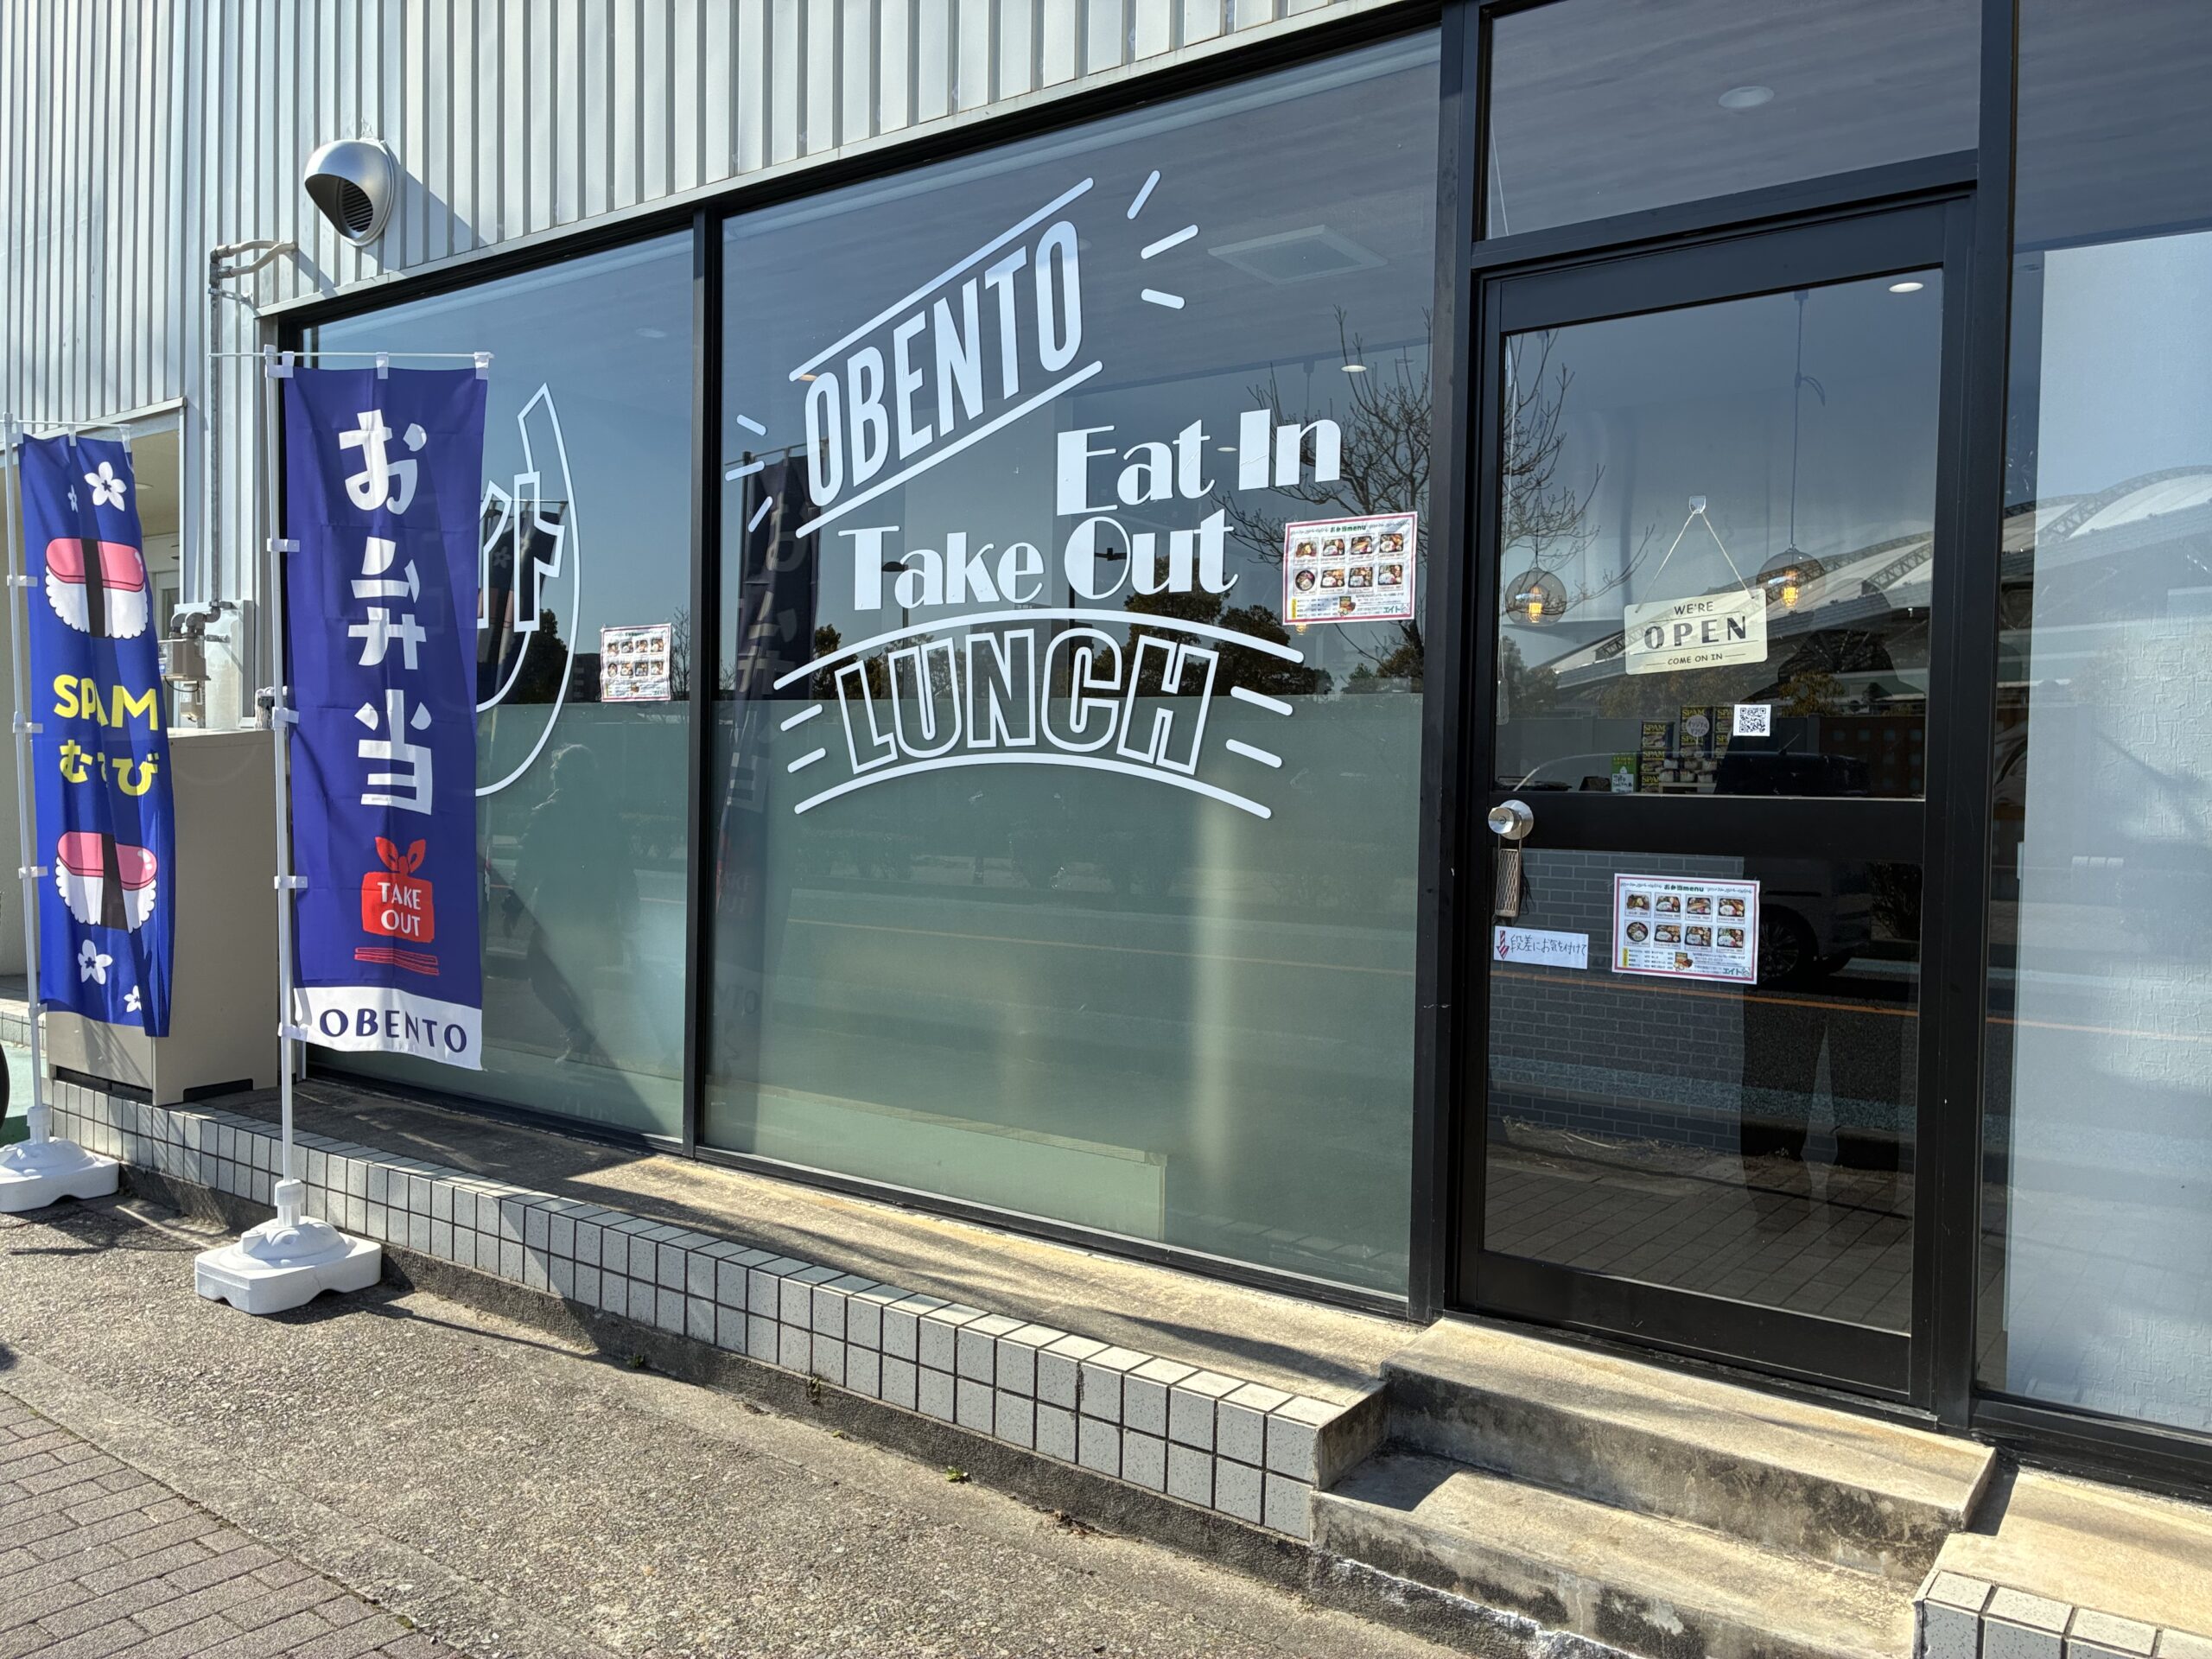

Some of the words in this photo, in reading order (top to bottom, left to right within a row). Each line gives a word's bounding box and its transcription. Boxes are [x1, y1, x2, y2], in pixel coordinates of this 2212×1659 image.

[804, 220, 1084, 507] OBENTO
[1057, 419, 1215, 517] Eat
[1238, 409, 1342, 491] In
[837, 525, 1045, 611] Take
[1064, 508, 1240, 601] Out
[339, 409, 433, 816] お弁当
[1674, 601, 1713, 615] WE'RE
[1644, 616, 1746, 650] OPEN
[1668, 655, 1692, 665] COME
[1694, 654, 1708, 663] ON
[54, 674, 159, 731] SPAM
[834, 628, 1220, 775] LUNCH
[1643, 750, 1666, 759] SPAM
[378, 882, 423, 910] TAKE
[381, 909, 421, 937] OUT
[1510, 934, 1587, 957] 段差にお気を付けて
[1723, 967, 1742, 976] エイト
[320, 1007, 467, 1053] OBENTO
